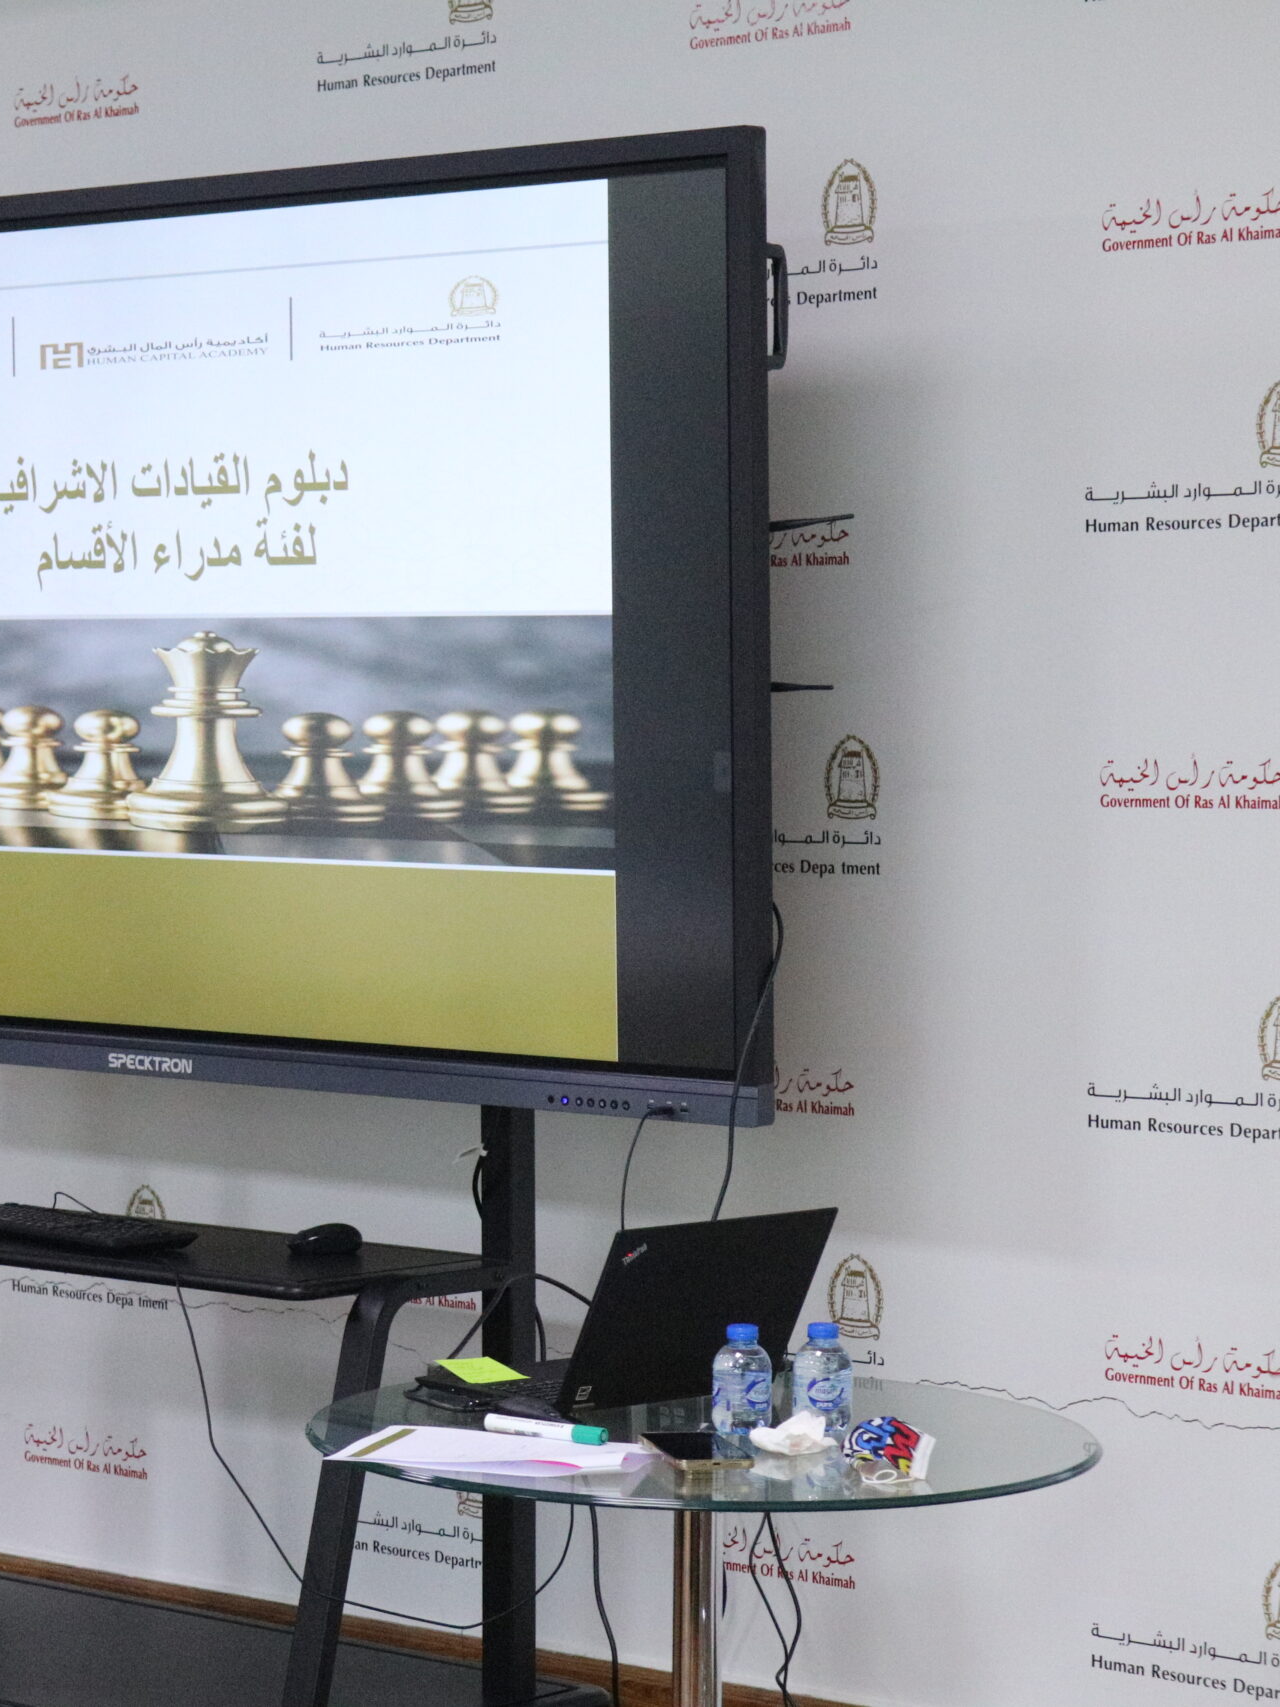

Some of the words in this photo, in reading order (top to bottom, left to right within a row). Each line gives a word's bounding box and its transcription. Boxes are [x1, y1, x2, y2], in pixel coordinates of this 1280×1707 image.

[453, 31, 497, 48] دائرة
[690, 34, 751, 50] Government
[755, 26, 768, 42] Of
[772, 26, 789, 41] Ras
[792, 22, 803, 37] Al
[807, 16, 851, 35] Khaimah
[317, 43, 389, 66] البشرية
[392, 36, 451, 59] الموارد
[317, 78, 358, 93] Human
[363, 71, 420, 87] Resources
[426, 60, 496, 83] Department
[14, 113, 61, 128] Government
[64, 108, 75, 123] Of
[77, 108, 91, 122] Ras
[94, 106, 102, 119] Al
[105, 102, 139, 118] Khaimah
[1102, 198, 1162, 233] الخيمة
[1169, 189, 1216, 229] رأس
[1102, 235, 1173, 252] Government
[1177, 231, 1192, 247] Of
[1197, 231, 1216, 245] Ras
[1221, 227, 1233, 243] Al
[1238, 225, 1280, 242] Khaima
[829, 255, 878, 276] دائرة
[797, 286, 877, 308] Department
[320, 343, 362, 351] Human
[366, 339, 424, 349] Resources
[428, 334, 501, 346] Department
[87, 356, 137, 366] HUMAN
[140, 351, 196, 362] CAPITAL
[200, 347, 269, 359] ACADEMY
[131, 451, 250, 510] القيادات
[264, 448, 349, 515] دبلوم
[1183, 480, 1261, 502] الموارد
[1085, 481, 1178, 504] البشرية
[1085, 518, 1139, 533] Human
[1146, 515, 1221, 531] Resources
[1228, 513, 1280, 532] Depart
[253, 516, 317, 566] لفئة
[37, 520, 137, 592] الأقسام
[153, 528, 242, 582] مدراء
[770, 554, 787, 567] Ras
[791, 553, 801, 567] Al
[806, 551, 849, 567] Khaimah
[1100, 758, 1159, 791] الخيمة
[1166, 752, 1214, 791] رأس
[1100, 794, 1170, 808] Government
[1175, 794, 1190, 809] Of
[1194, 795, 1214, 809] Ras
[1218, 795, 1230, 809] Al
[774, 829, 829, 846] الموا
[833, 830, 881, 848] دائرة
[108, 1052, 193, 1074] SPECKTRON
[798, 1068, 854, 1097] حكومة
[1087, 1082, 1181, 1105] البشرية
[776, 1099, 793, 1112] Ras
[796, 1100, 807, 1113] Al
[811, 1101, 854, 1116] Khaimah
[1185, 1088, 1263, 1108] الموارد
[1088, 1114, 1141, 1131] Human
[1148, 1117, 1223, 1136] Resources
[12, 1278, 48, 1296] Human
[52, 1286, 103, 1303] Resources
[438, 1295, 476, 1311] Khaimah
[1105, 1334, 1163, 1368] الخيمة
[1170, 1336, 1217, 1373] رأس
[1105, 1367, 1174, 1388] Government
[1179, 1376, 1194, 1390] Of
[1199, 1378, 1218, 1393] Ras
[1222, 1380, 1234, 1395] Al
[1239, 1383, 1280, 1400] Khaima
[24, 1450, 71, 1468] Government
[74, 1458, 84, 1470] Of
[87, 1460, 100, 1473] Ras
[103, 1462, 111, 1474] Al
[114, 1464, 148, 1480] Khaimah
[357, 1511, 398, 1531] البش
[401, 1519, 460, 1538] الموارد
[373, 1540, 430, 1561] Resources
[798, 1539, 855, 1568] حكومة
[761, 1563, 774, 1577] Of
[778, 1568, 793, 1581] Rs
[798, 1569, 808, 1582] Al
[812, 1571, 855, 1589] Khaimah
[1091, 1622, 1185, 1653] البشرية
[1190, 1642, 1267, 1665] الموارد
[1091, 1654, 1145, 1676] Human
[1151, 1664, 1226, 1690] Resources
[1233, 1678, 1280, 1701] Depar
